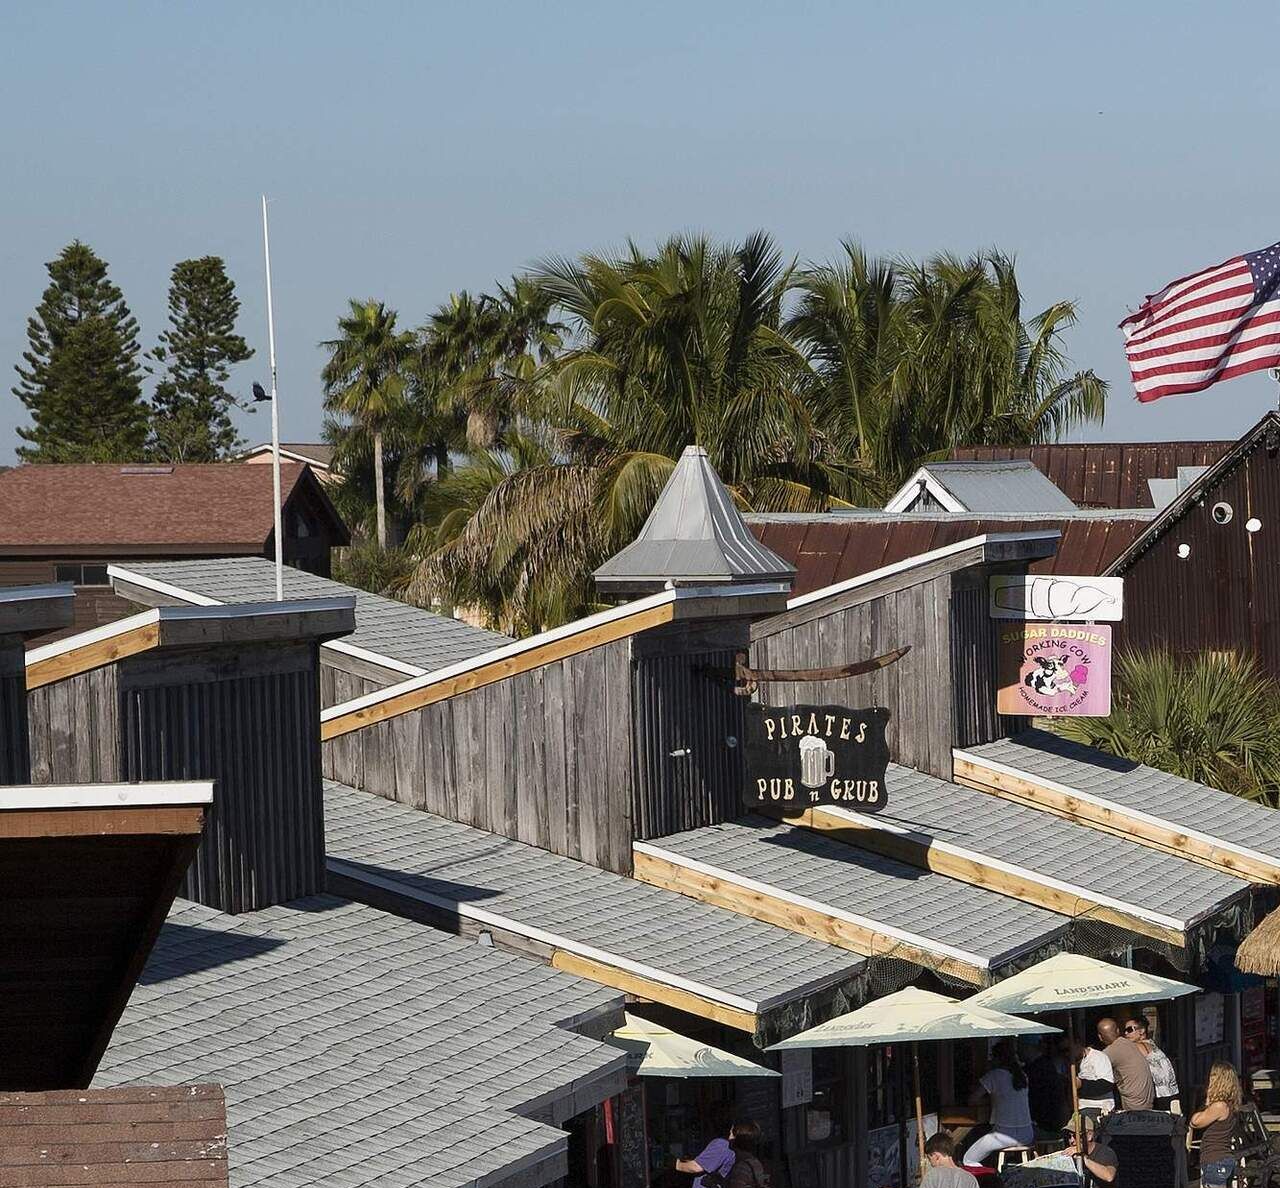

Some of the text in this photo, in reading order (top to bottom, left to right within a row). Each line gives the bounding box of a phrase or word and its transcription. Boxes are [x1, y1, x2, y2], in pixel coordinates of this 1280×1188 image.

[1002, 628, 1107, 646] SUGAR DADDIES
[1069, 645, 1091, 665] COW
[764, 713, 867, 743] PIRATES
[757, 778, 795, 800] PUB
[809, 790, 820, 802] n
